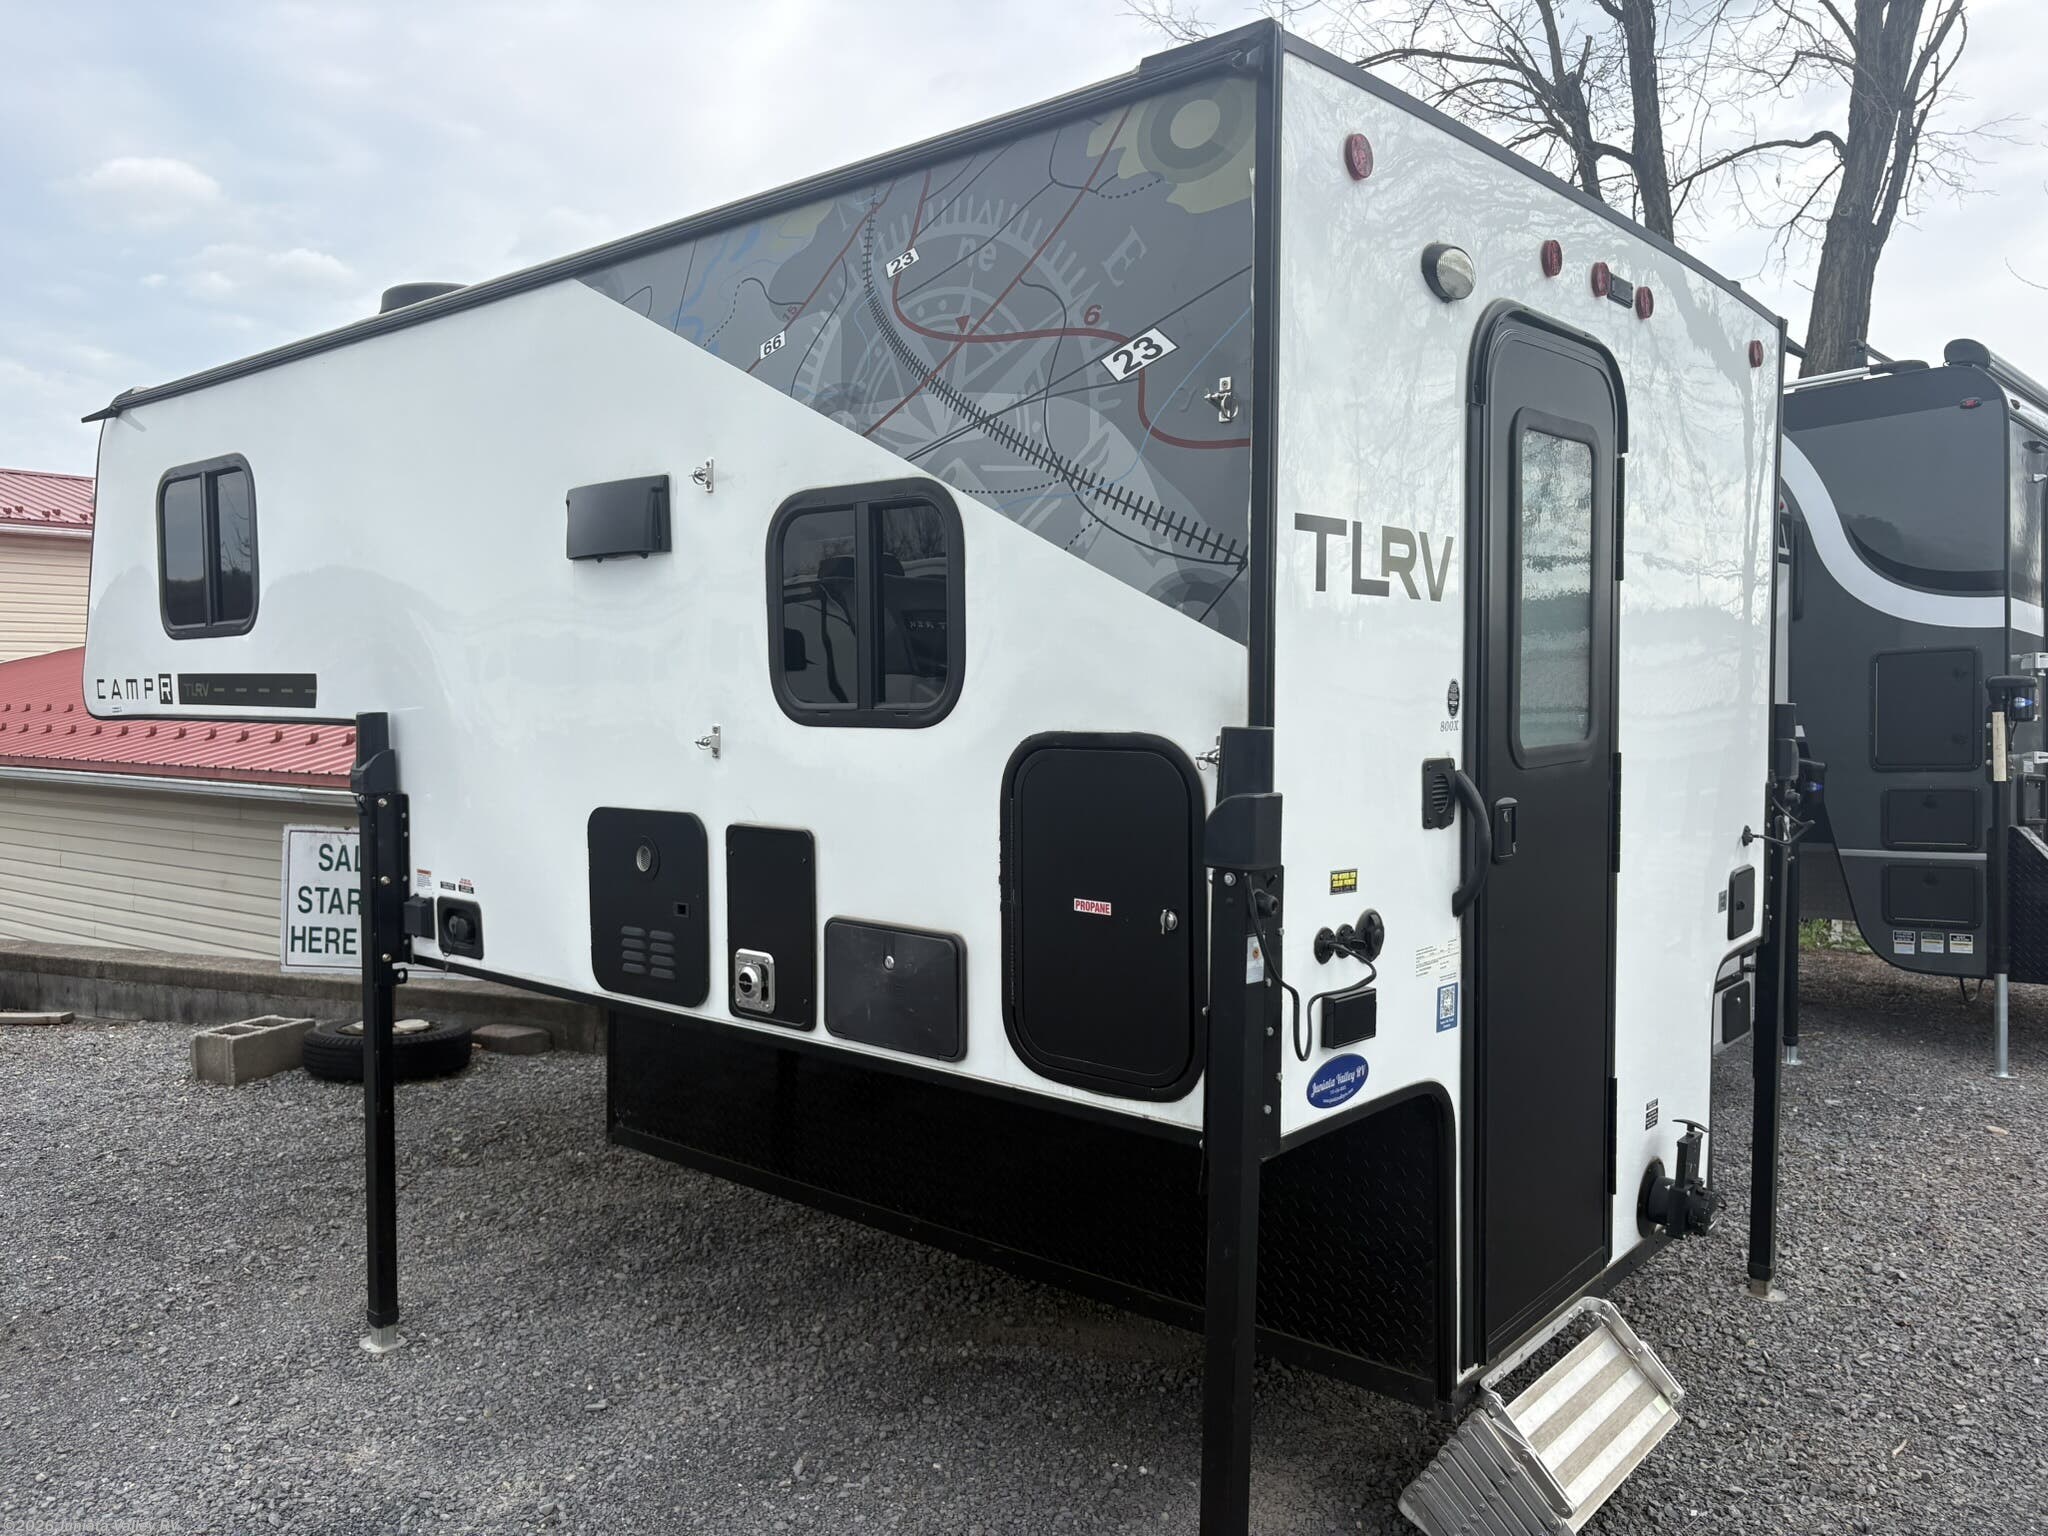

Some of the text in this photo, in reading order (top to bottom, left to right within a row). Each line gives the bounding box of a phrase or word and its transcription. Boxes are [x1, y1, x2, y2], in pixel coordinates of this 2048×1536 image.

[890, 252, 914, 274] 23
[1083, 304, 1103, 326] 6
[762, 335, 783, 356] 66
[1112, 336, 1164, 375] 23
[1294, 512, 1455, 602] TLRV
[183, 681, 210, 698] TLRV
[318, 843, 361, 873] SAL
[297, 885, 361, 915] STAR
[1075, 900, 1111, 914] PROPANE
[290, 925, 357, 955] HERE
